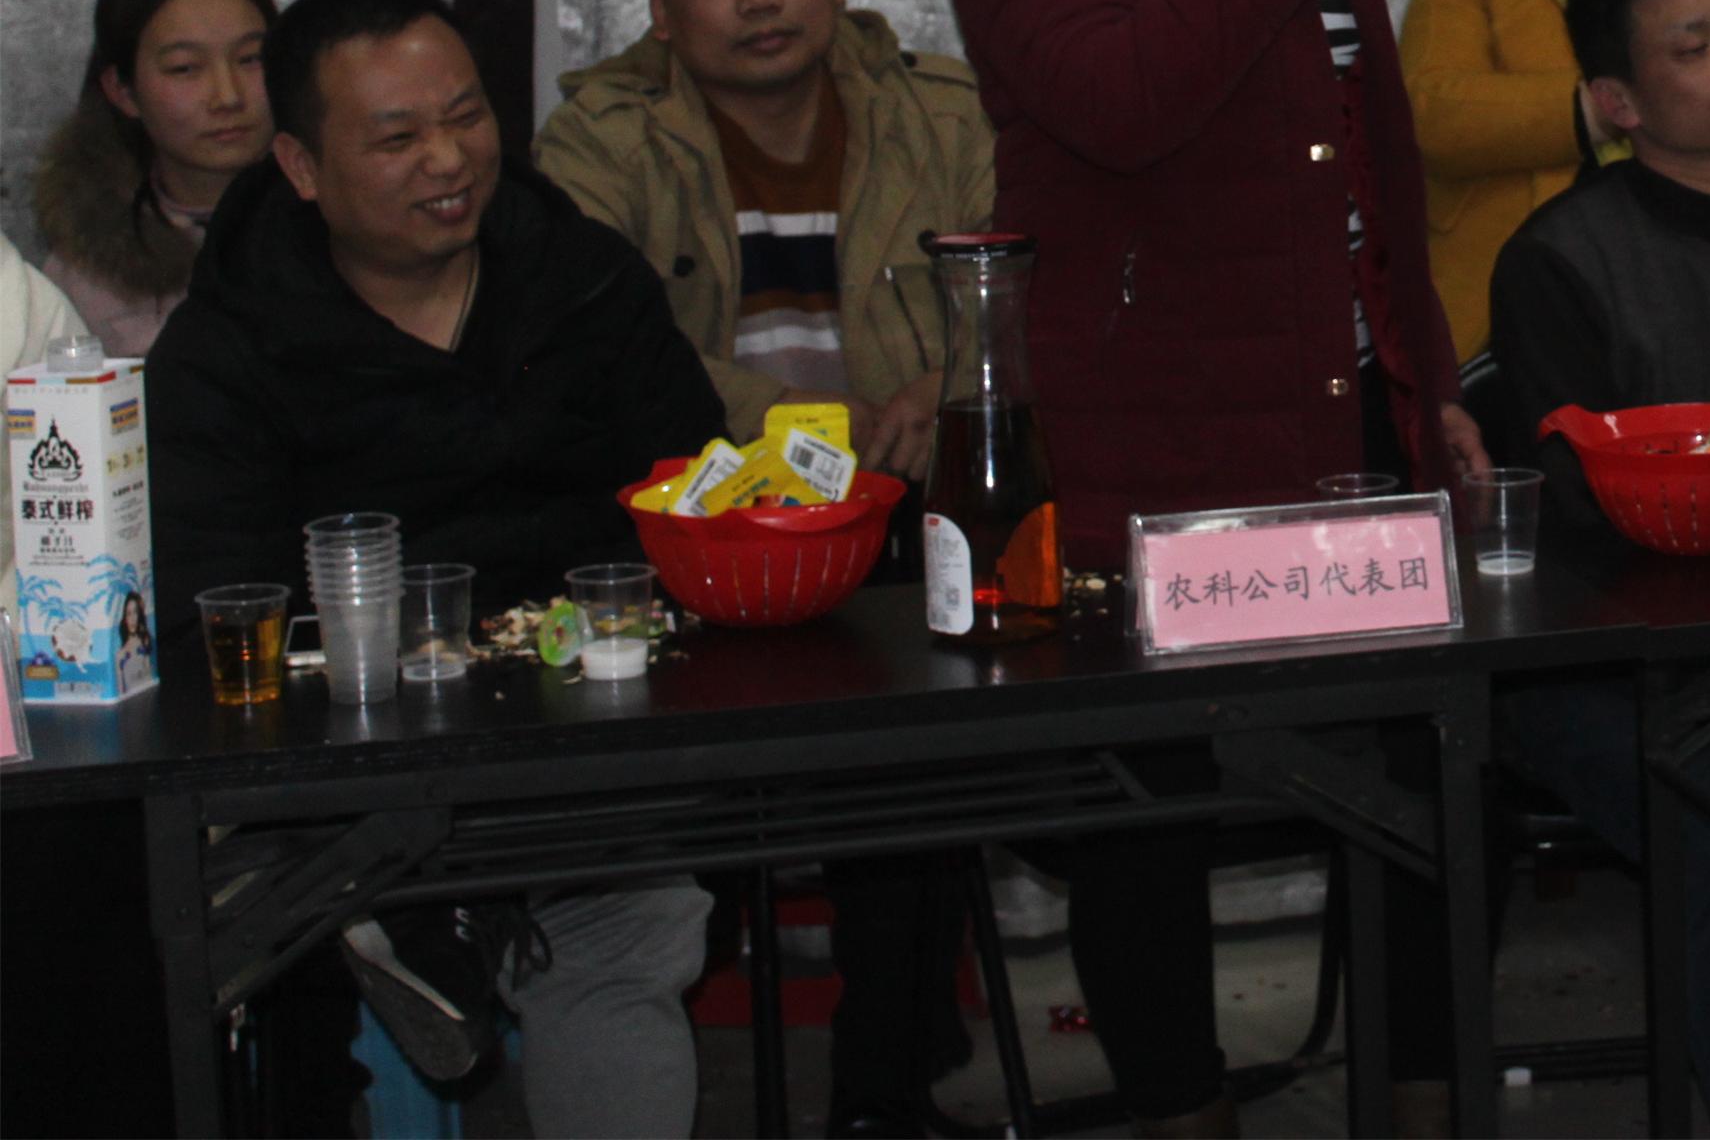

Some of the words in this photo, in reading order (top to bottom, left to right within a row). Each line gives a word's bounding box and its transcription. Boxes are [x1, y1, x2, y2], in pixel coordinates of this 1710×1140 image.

[22, 500, 94, 520] 泰式鲜榨
[1163, 555, 1430, 612] 农科公司代表团
